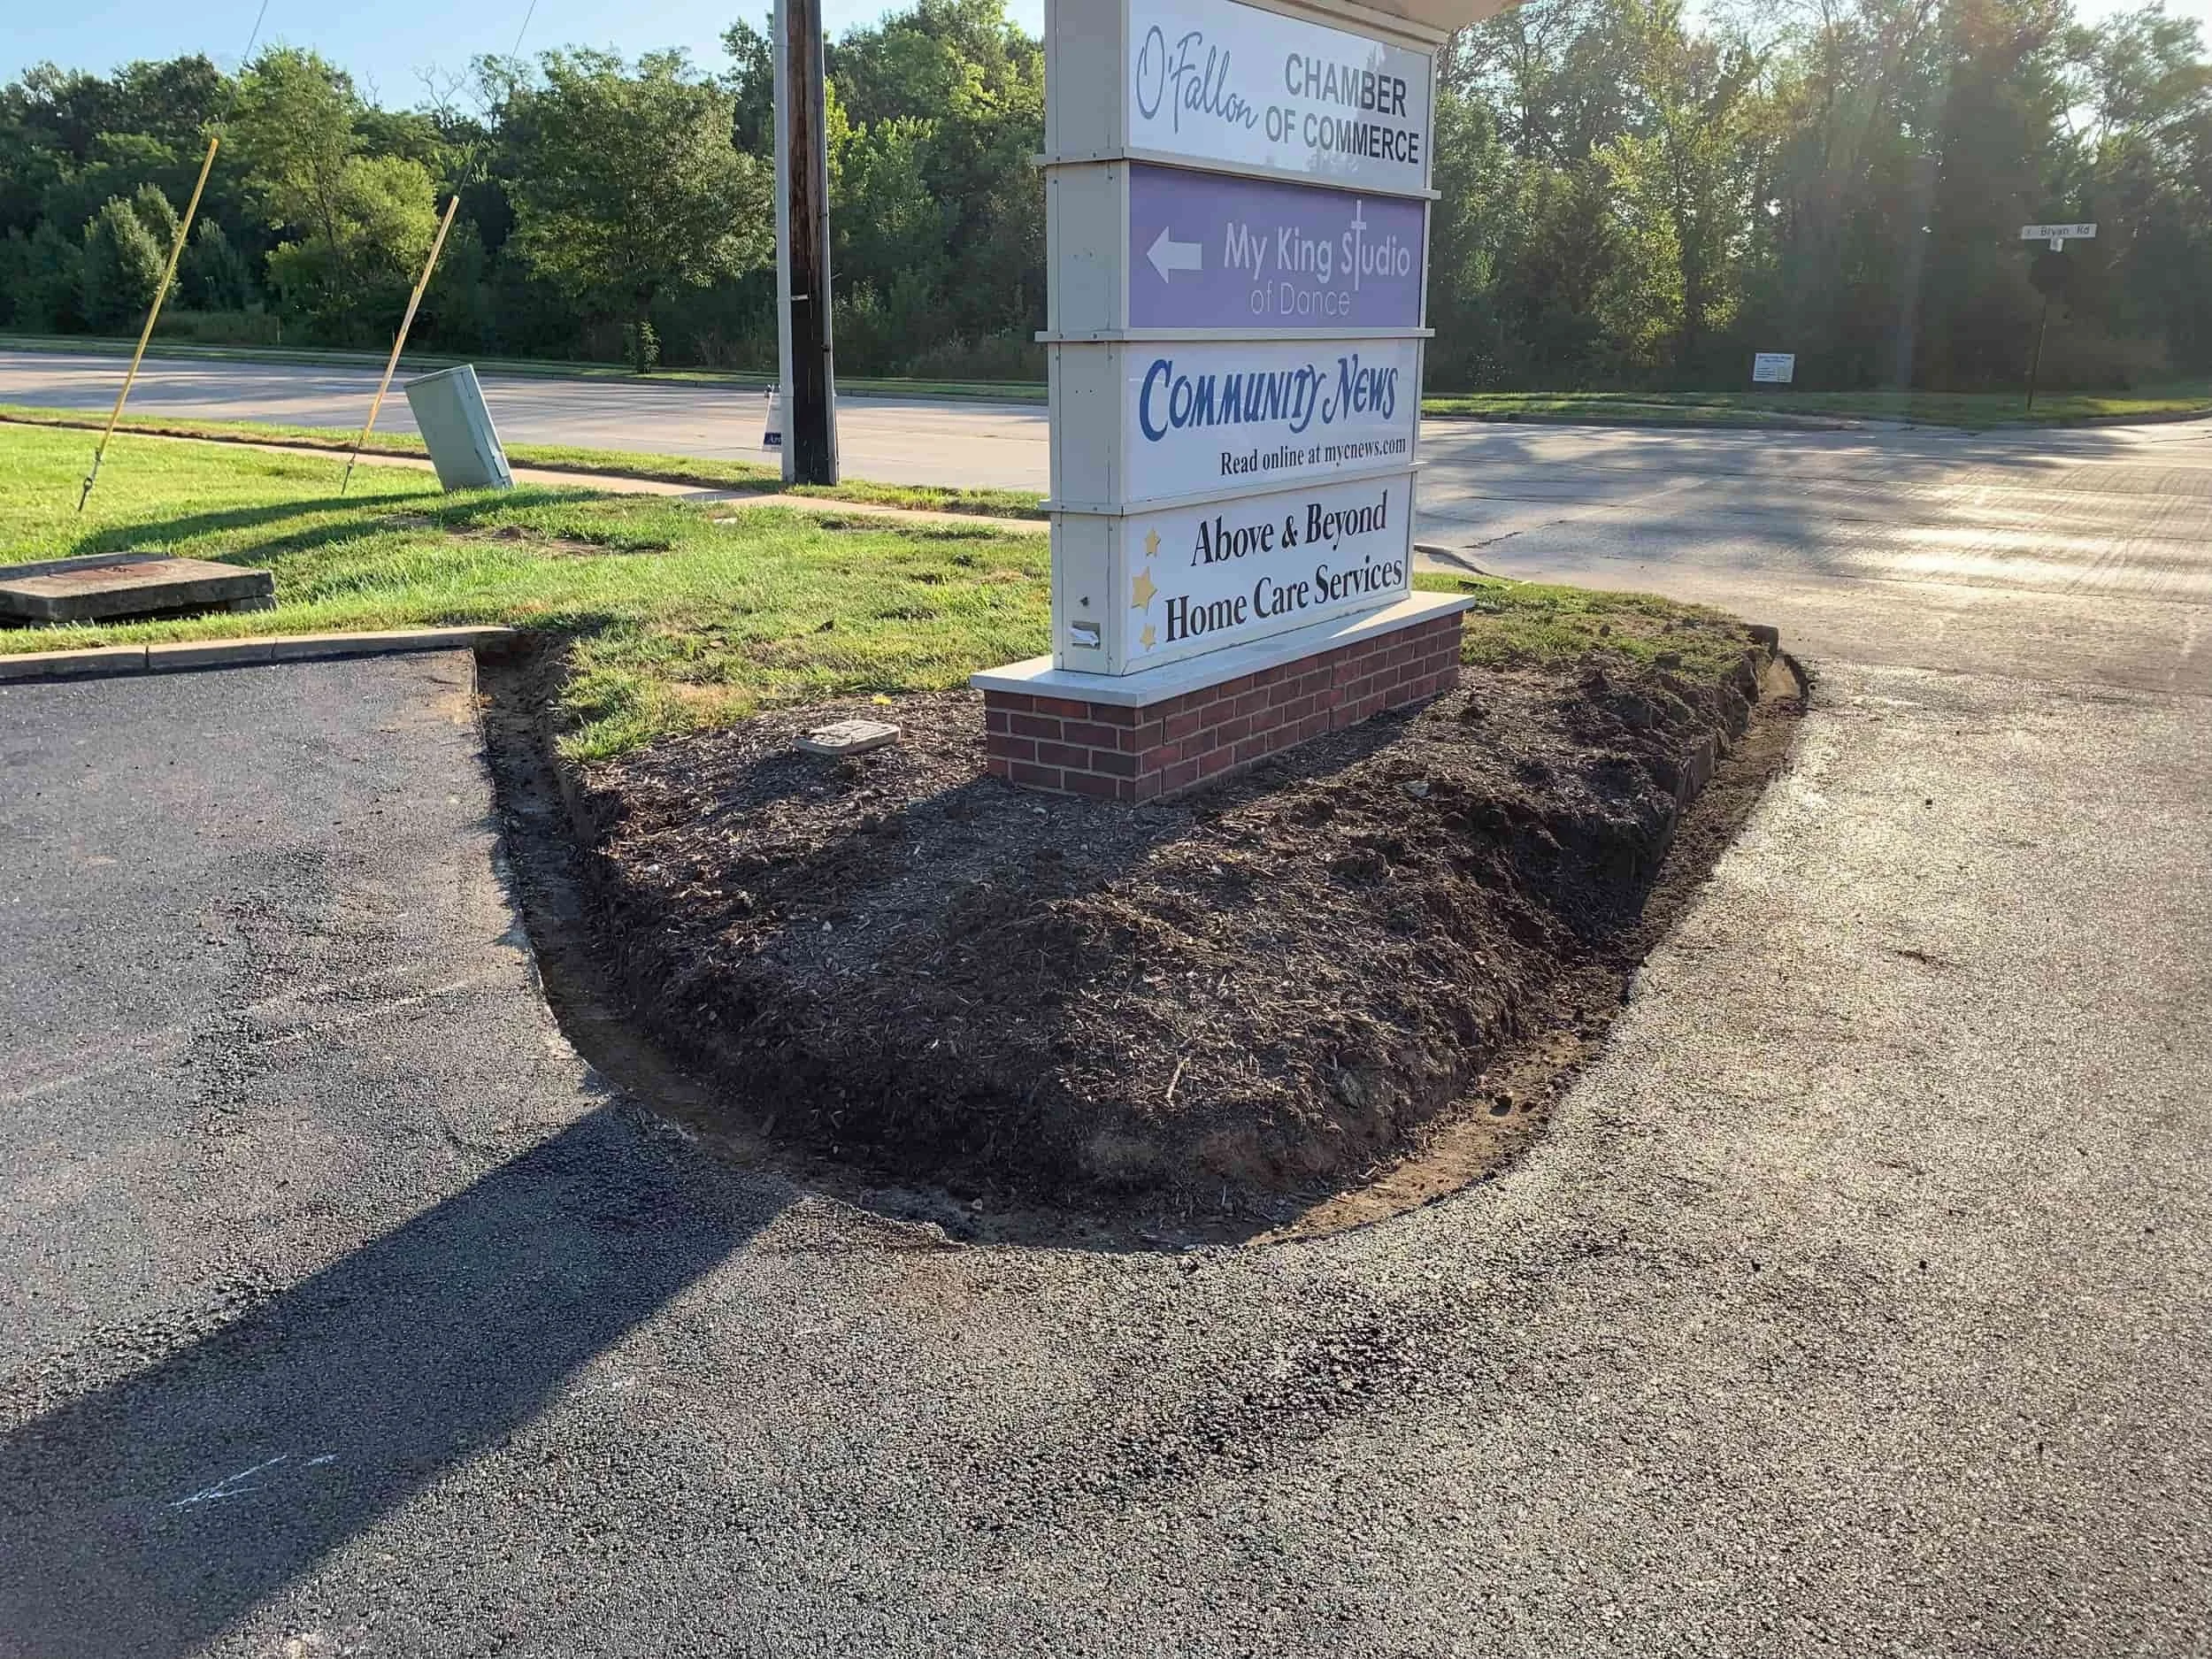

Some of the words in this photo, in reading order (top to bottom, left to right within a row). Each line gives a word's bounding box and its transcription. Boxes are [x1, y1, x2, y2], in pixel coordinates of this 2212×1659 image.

[1136, 25, 1260, 134] O'Fallon
[1285, 53, 1407, 118] CHAMBER
[1265, 105, 1296, 142] OF
[1303, 112, 1419, 165] COMMERCE
[1225, 222, 1267, 280] My
[1277, 220, 1333, 282] King
[1341, 199, 1410, 291] Studio
[1251, 280, 1274, 315] of
[1280, 282, 1351, 317] Dance
[1221, 452, 1258, 476] Read
[1263, 448, 1304, 472] online
[1309, 445, 1322, 465] at
[1324, 436, 1407, 472] mycnews.com
[1190, 514, 1274, 567] Above
[1281, 516, 1299, 549] &
[1304, 489, 1387, 549] Beyond
[1165, 594, 1248, 642] Home
[1254, 578, 1309, 618] Care
[1314, 555, 1402, 604] Services
